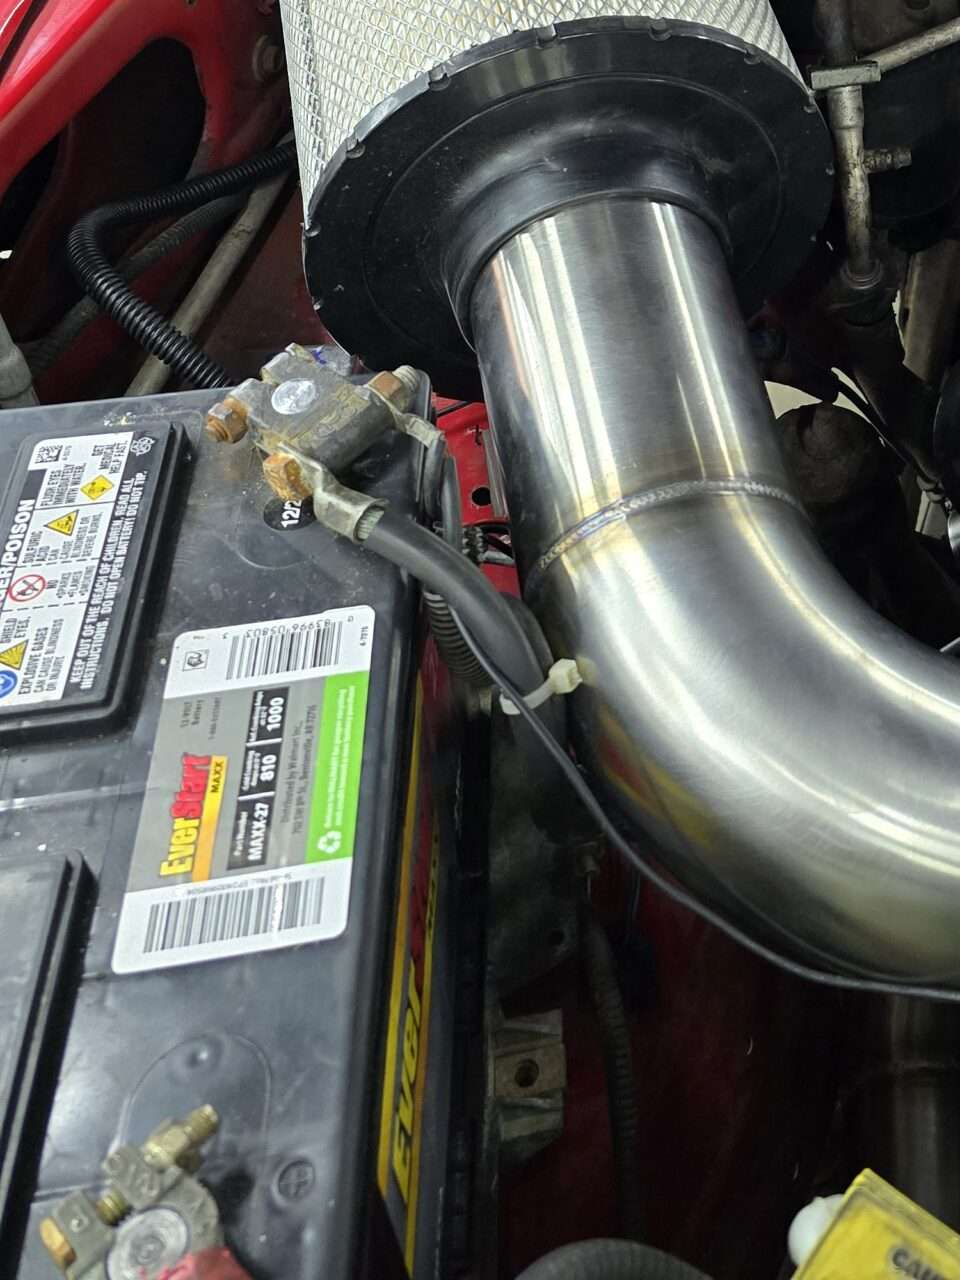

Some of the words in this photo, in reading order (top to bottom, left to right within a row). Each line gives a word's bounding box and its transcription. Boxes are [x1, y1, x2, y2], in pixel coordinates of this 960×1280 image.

[92, 444, 106, 456] GET
[98, 442, 117, 470] MEDICAL
[109, 458, 121, 474] HELP
[41, 485, 54, 507] FLUSH
[48, 469, 61, 484] EYES
[53, 463, 75, 505] IMMEDIATELY
[121, 477, 135, 493] ALL
[135, 470, 148, 488] TIP.
[65, 487, 78, 504] WITH
[115, 494, 130, 517] READ
[131, 487, 144, 502] NOT
[127, 502, 140, 518] DO
[22, 530, 42, 563] SULFURIC
[35, 545, 50, 562] ACID
[48, 548, 60, 562] CAN
[60, 539, 74, 560] CAUSE
[81, 535, 98, 558] SEVERE
[99, 563, 112, 575] OF
[110, 556, 126, 581] OPEN
[47, 579, 58, 589] NO
[91, 575, 108, 605] REACH
[104, 581, 120, 600] NOT
[86, 606, 101, 623] THE
[101, 600, 115, 614] DO
[1, 618, 17, 643] SHIELD
[45, 619, 64, 655] BLINDNESS
[82, 626, 95, 638] OF
[76, 638, 92, 658] OUT
[80, 617, 111, 690] INSTRUCTIONS.
[18, 653, 41, 695] EXPLOSIVE
[32, 626, 48, 652] GASES
[38, 655, 54, 678] CAUSE
[69, 659, 83, 683] KEEP
[33, 679, 46, 693] CAN
[45, 681, 57, 692] OR
[266, 696, 285, 732] 1000
[210, 761, 225, 794] MAXX
[259, 754, 277, 782] 810
[159, 752, 212, 877] EverStart
[247, 802, 270, 861] MAXX-27
